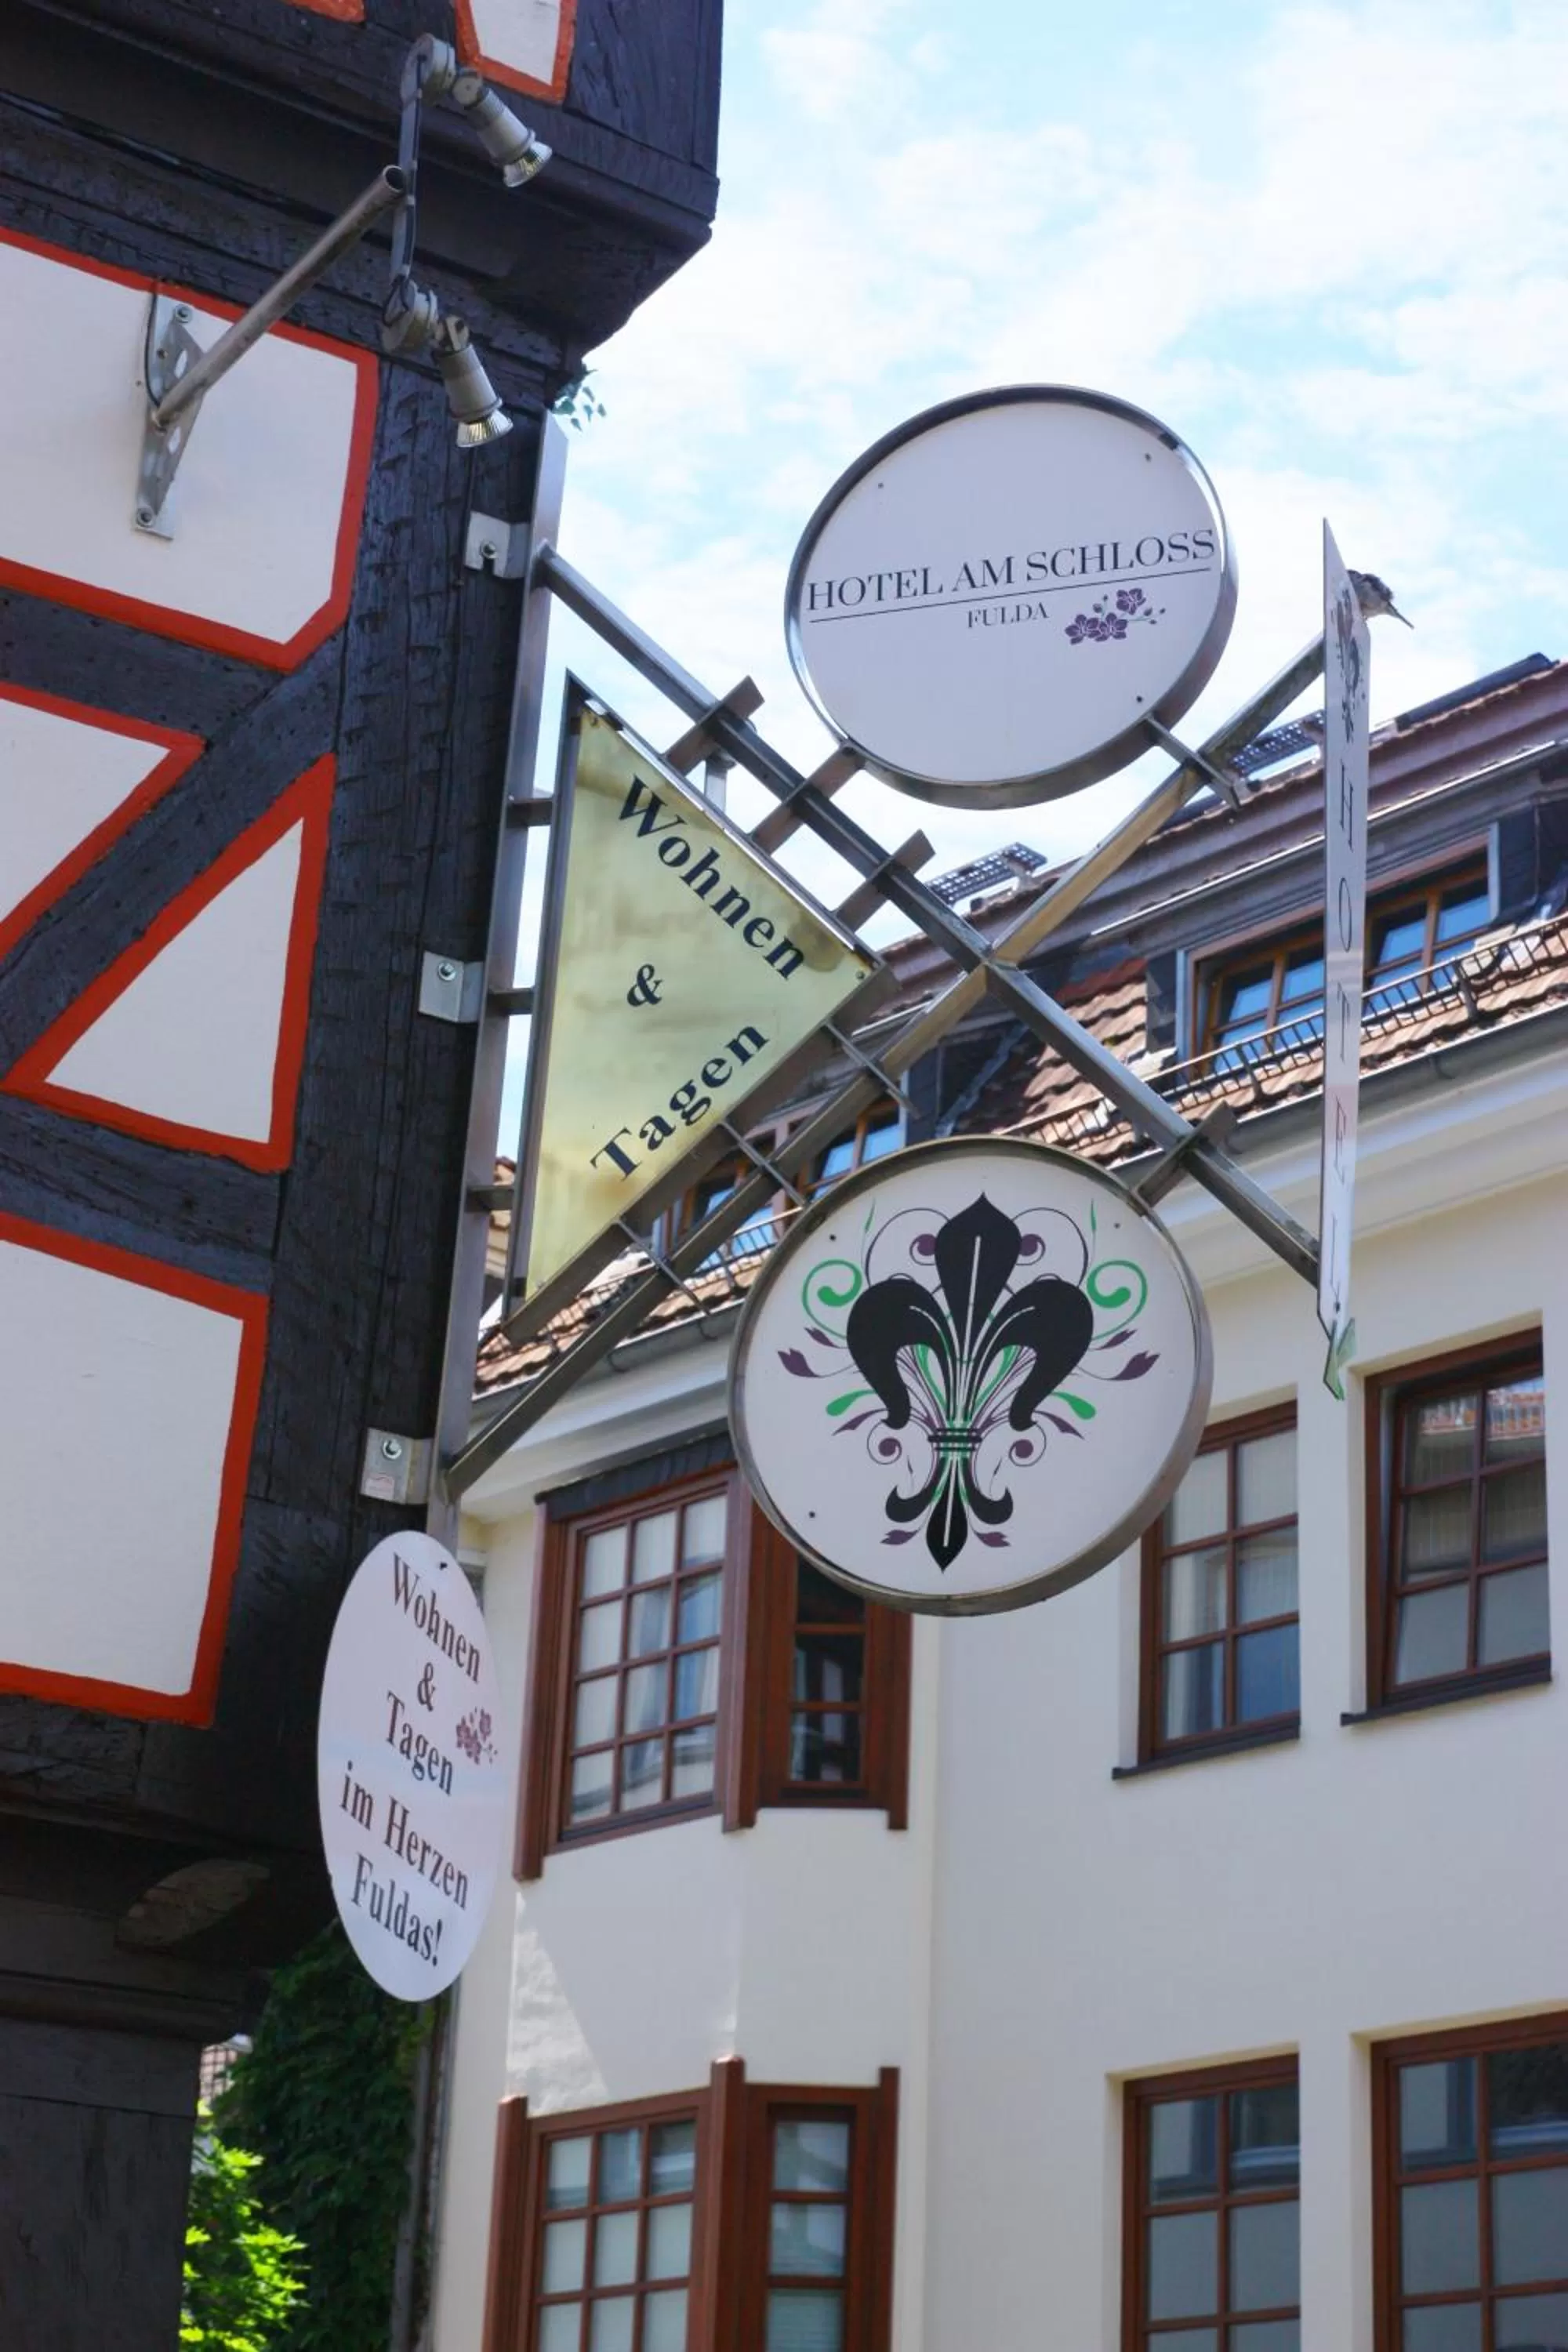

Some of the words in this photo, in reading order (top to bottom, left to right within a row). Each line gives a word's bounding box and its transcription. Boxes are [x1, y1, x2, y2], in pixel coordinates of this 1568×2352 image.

[806, 566, 943, 611] HOTEL
[951, 557, 1015, 592] AM
[1025, 529, 1215, 582] SCHLOSS
[967, 602, 1050, 627] FULDA
[618, 774, 805, 981] Wohnen
[626, 964, 662, 1008] &
[1330, 758, 1354, 1301] HOTEL
[591, 1022, 768, 1182] Tagen
[392, 1553, 481, 1682] Wohnen
[386, 1692, 452, 1795] Tagen
[417, 1662, 435, 1711] &
[340, 1760, 374, 1831] im
[384, 1795, 469, 1911] Herzen
[351, 1853, 443, 1967] Fuldas!
